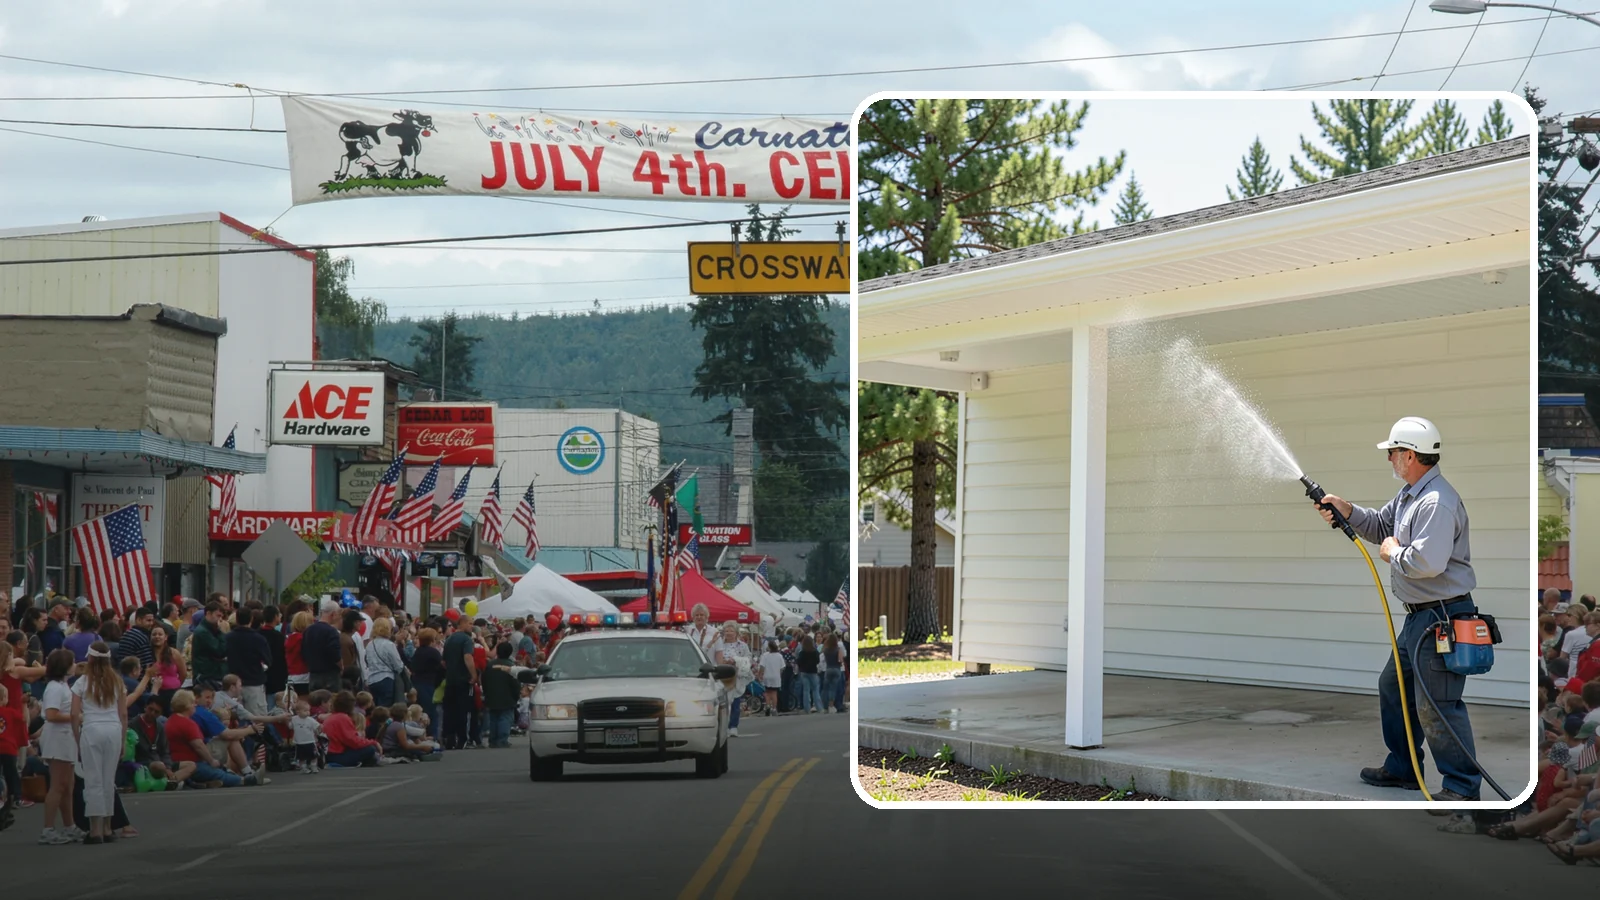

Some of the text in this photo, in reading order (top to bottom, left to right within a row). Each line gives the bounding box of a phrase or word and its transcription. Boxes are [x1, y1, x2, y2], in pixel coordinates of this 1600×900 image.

[695, 121, 850, 149] Carnat
[481, 141, 604, 192] JULY
[632, 151, 746, 197] 4th.
[697, 254, 850, 280] CROSSWA
[283, 380, 373, 420] ACE
[406, 409, 452, 421] CEDAR
[283, 421, 370, 436] Hardware
[353, 467, 386, 479] Simpl
[83, 485, 155, 496] St. Vincent de Paul
